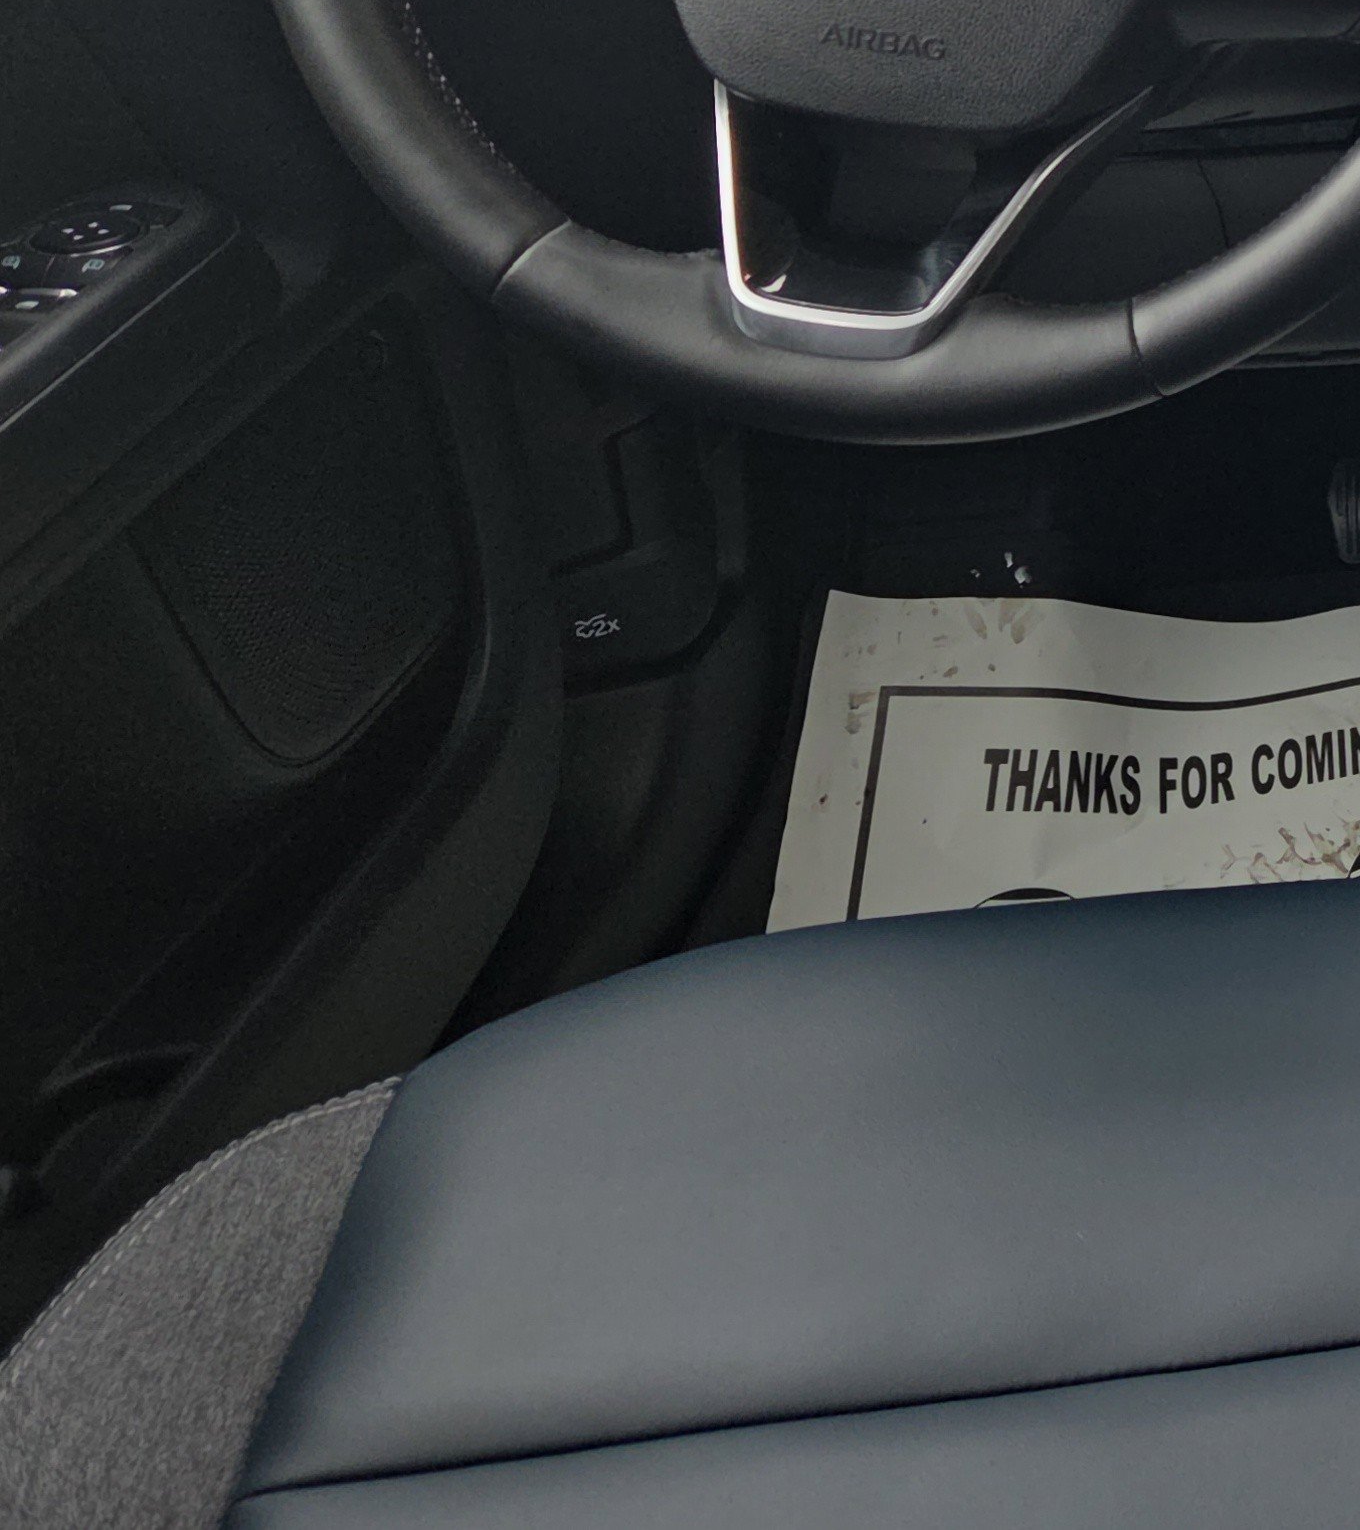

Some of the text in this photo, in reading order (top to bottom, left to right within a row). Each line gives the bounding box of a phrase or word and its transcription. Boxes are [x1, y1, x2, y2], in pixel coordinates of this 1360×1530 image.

[819, 22, 947, 60] AIRBAG
[982, 746, 1141, 815] THANKS
[1157, 749, 1236, 815] FOR
